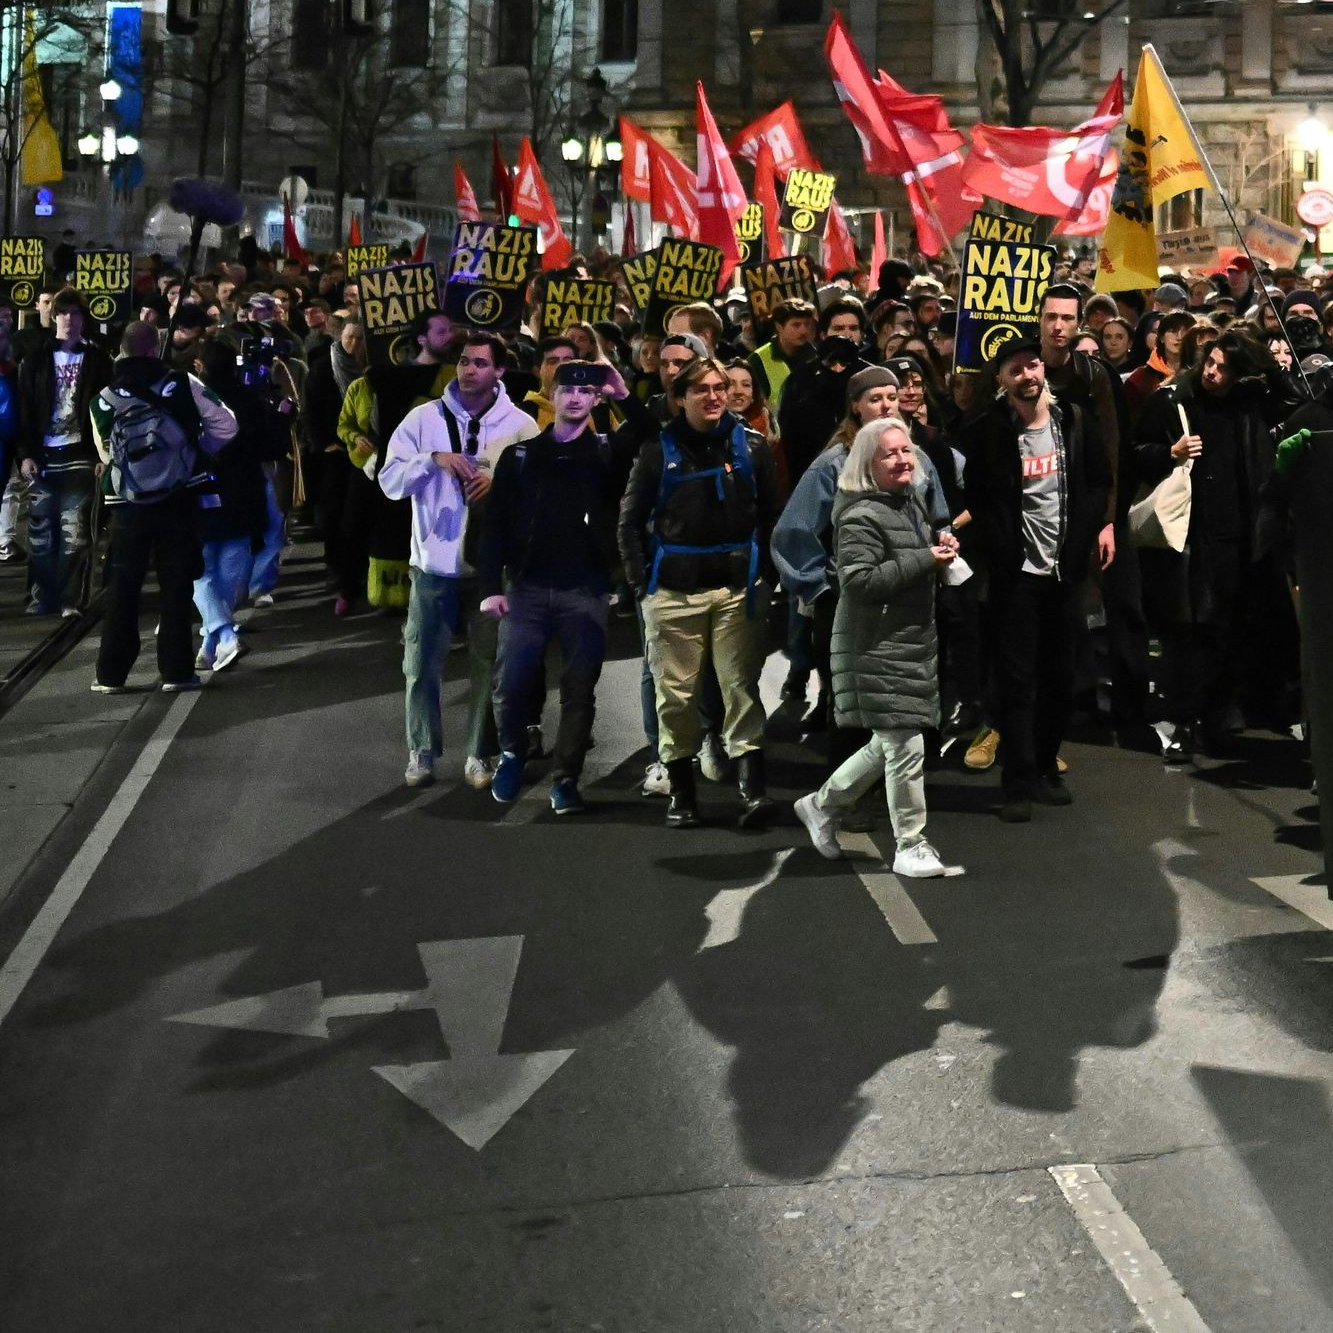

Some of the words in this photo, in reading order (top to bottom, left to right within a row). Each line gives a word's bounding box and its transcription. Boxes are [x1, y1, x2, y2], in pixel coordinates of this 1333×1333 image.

[788, 170, 835, 190] NAZIS
[785, 184, 832, 208] RAUS
[456, 224, 533, 255] NAZIS
[968, 214, 1033, 243] NAZIS
[1, 238, 44, 256] NAZIS
[348, 246, 387, 262] NAZIS
[661, 241, 722, 272] NAZIS
[1, 256, 44, 275] RAUS
[76, 253, 130, 271] NAZIS
[452, 249, 528, 284] RAUS
[746, 258, 810, 290] NAZIS
[967, 244, 1052, 280] NAZIS
[76, 270, 130, 290] RAUS
[360, 266, 434, 299] NAZIS
[546, 281, 613, 306] NAZIS
[655, 265, 717, 300] RAUS
